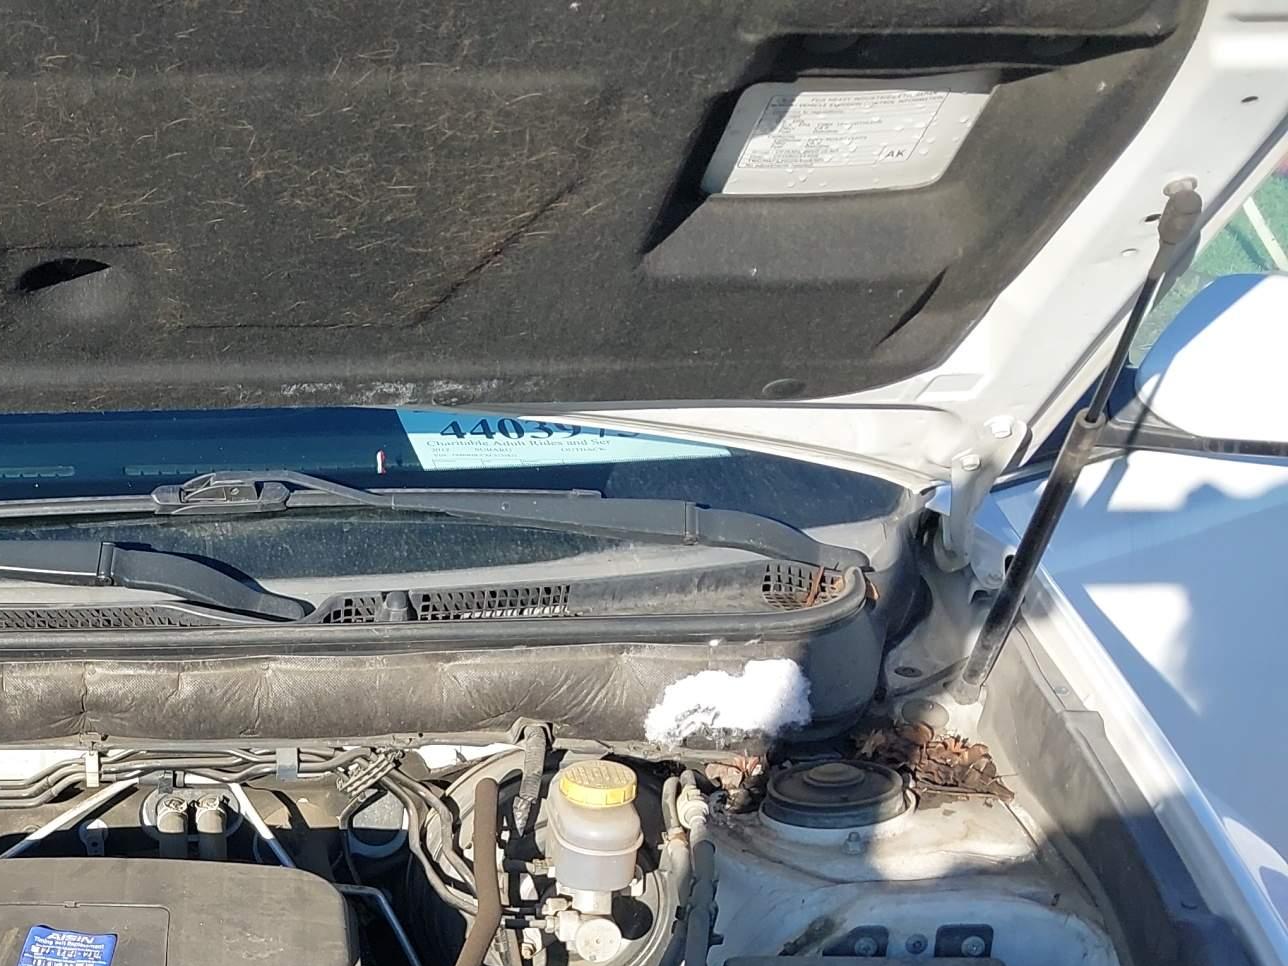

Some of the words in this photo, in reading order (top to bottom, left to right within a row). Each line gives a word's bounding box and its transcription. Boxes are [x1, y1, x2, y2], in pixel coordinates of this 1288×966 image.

[886, 149, 906, 158] AK
[426, 439, 489, 448] Charitable
[493, 439, 525, 447] Adult
[528, 439, 563, 447] Rides
[565, 438, 588, 446] and
[46, 932, 95, 944] AISIN
